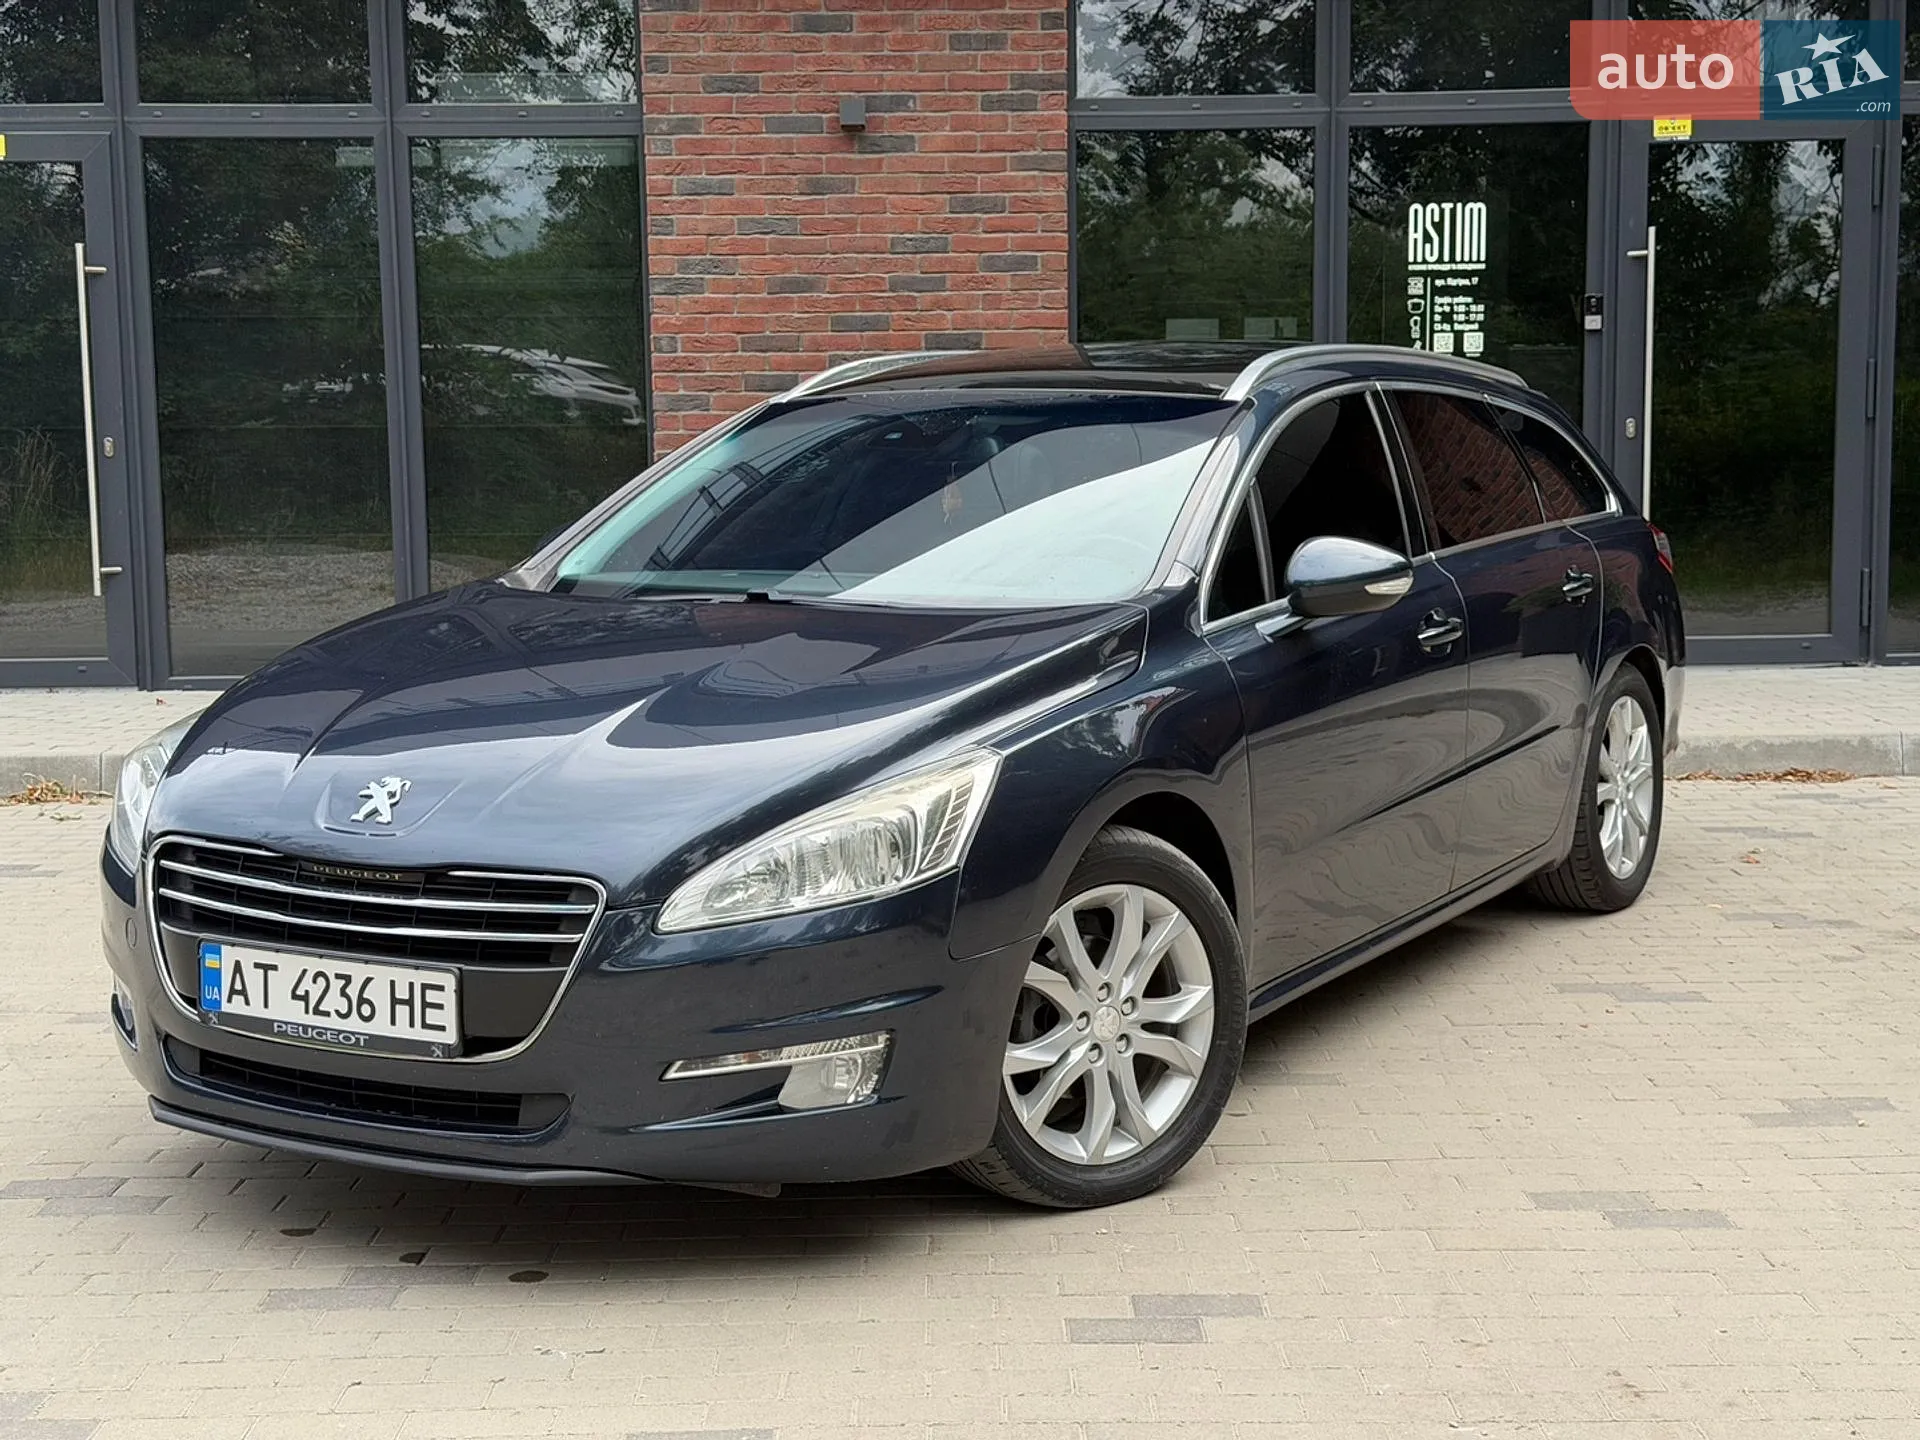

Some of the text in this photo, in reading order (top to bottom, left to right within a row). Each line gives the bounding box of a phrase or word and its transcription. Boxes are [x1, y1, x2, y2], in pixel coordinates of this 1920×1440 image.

[1408, 202, 1487, 263] ASTIM
[312, 863, 402, 881] PEUGEOT
[205, 986, 220, 1000] UA
[226, 959, 448, 1033] AT 4236 HE
[273, 1021, 370, 1047] PEUGEOT
